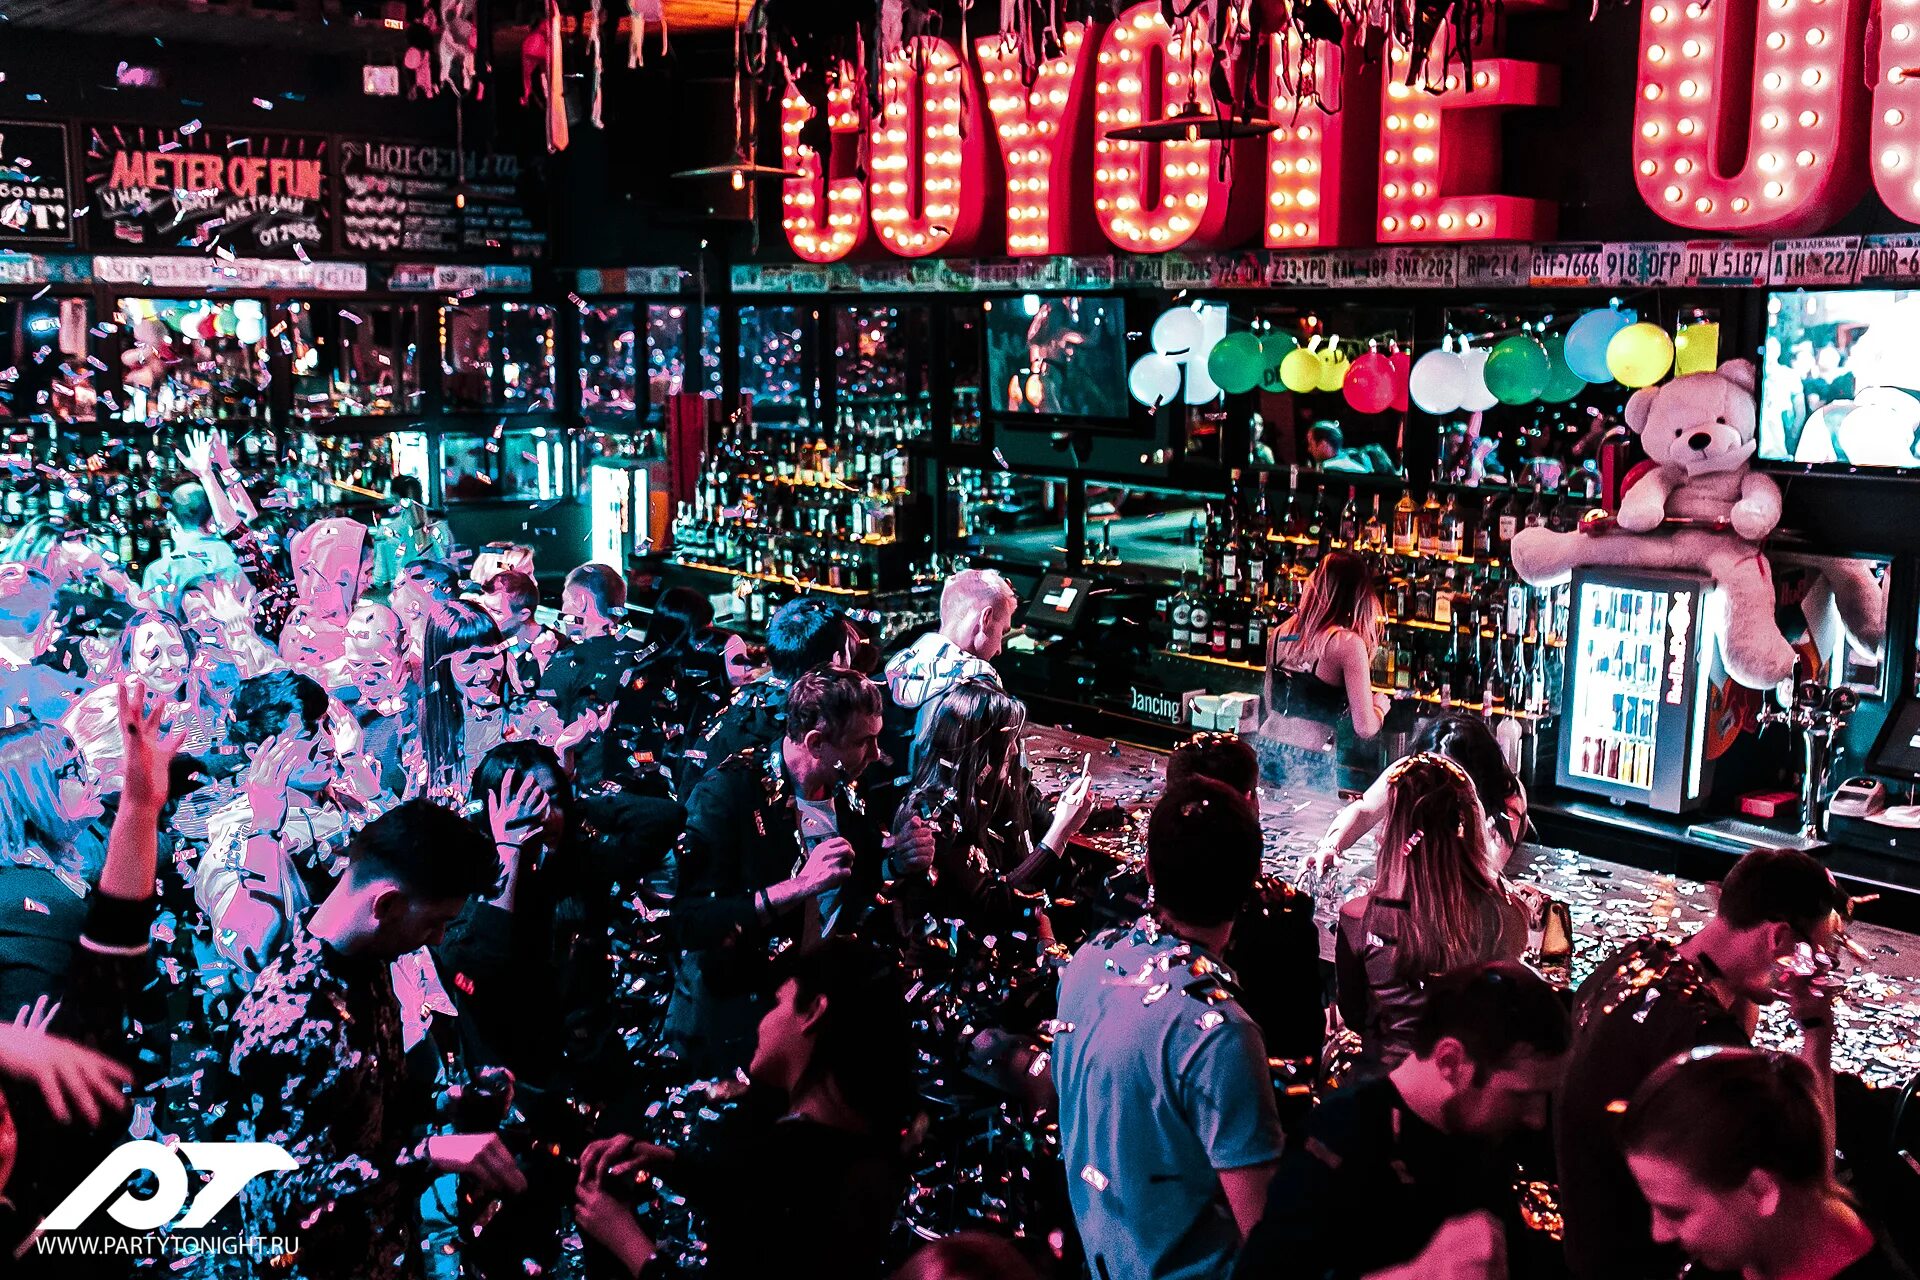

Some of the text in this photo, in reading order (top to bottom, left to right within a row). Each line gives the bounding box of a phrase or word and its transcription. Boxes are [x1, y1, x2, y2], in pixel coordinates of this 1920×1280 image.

[1633, 0, 1920, 229] U
[109, 150, 224, 191] METER
[227, 156, 267, 197] OF
[268, 158, 322, 200] FUN
[225, 194, 305, 223] МЕТРАМИ
[1606, 252, 1681, 278] 918 DFP
[1688, 251, 1763, 277] DLV 5187
[1823, 250, 1857, 276] 227
[1868, 248, 1899, 275] DDR
